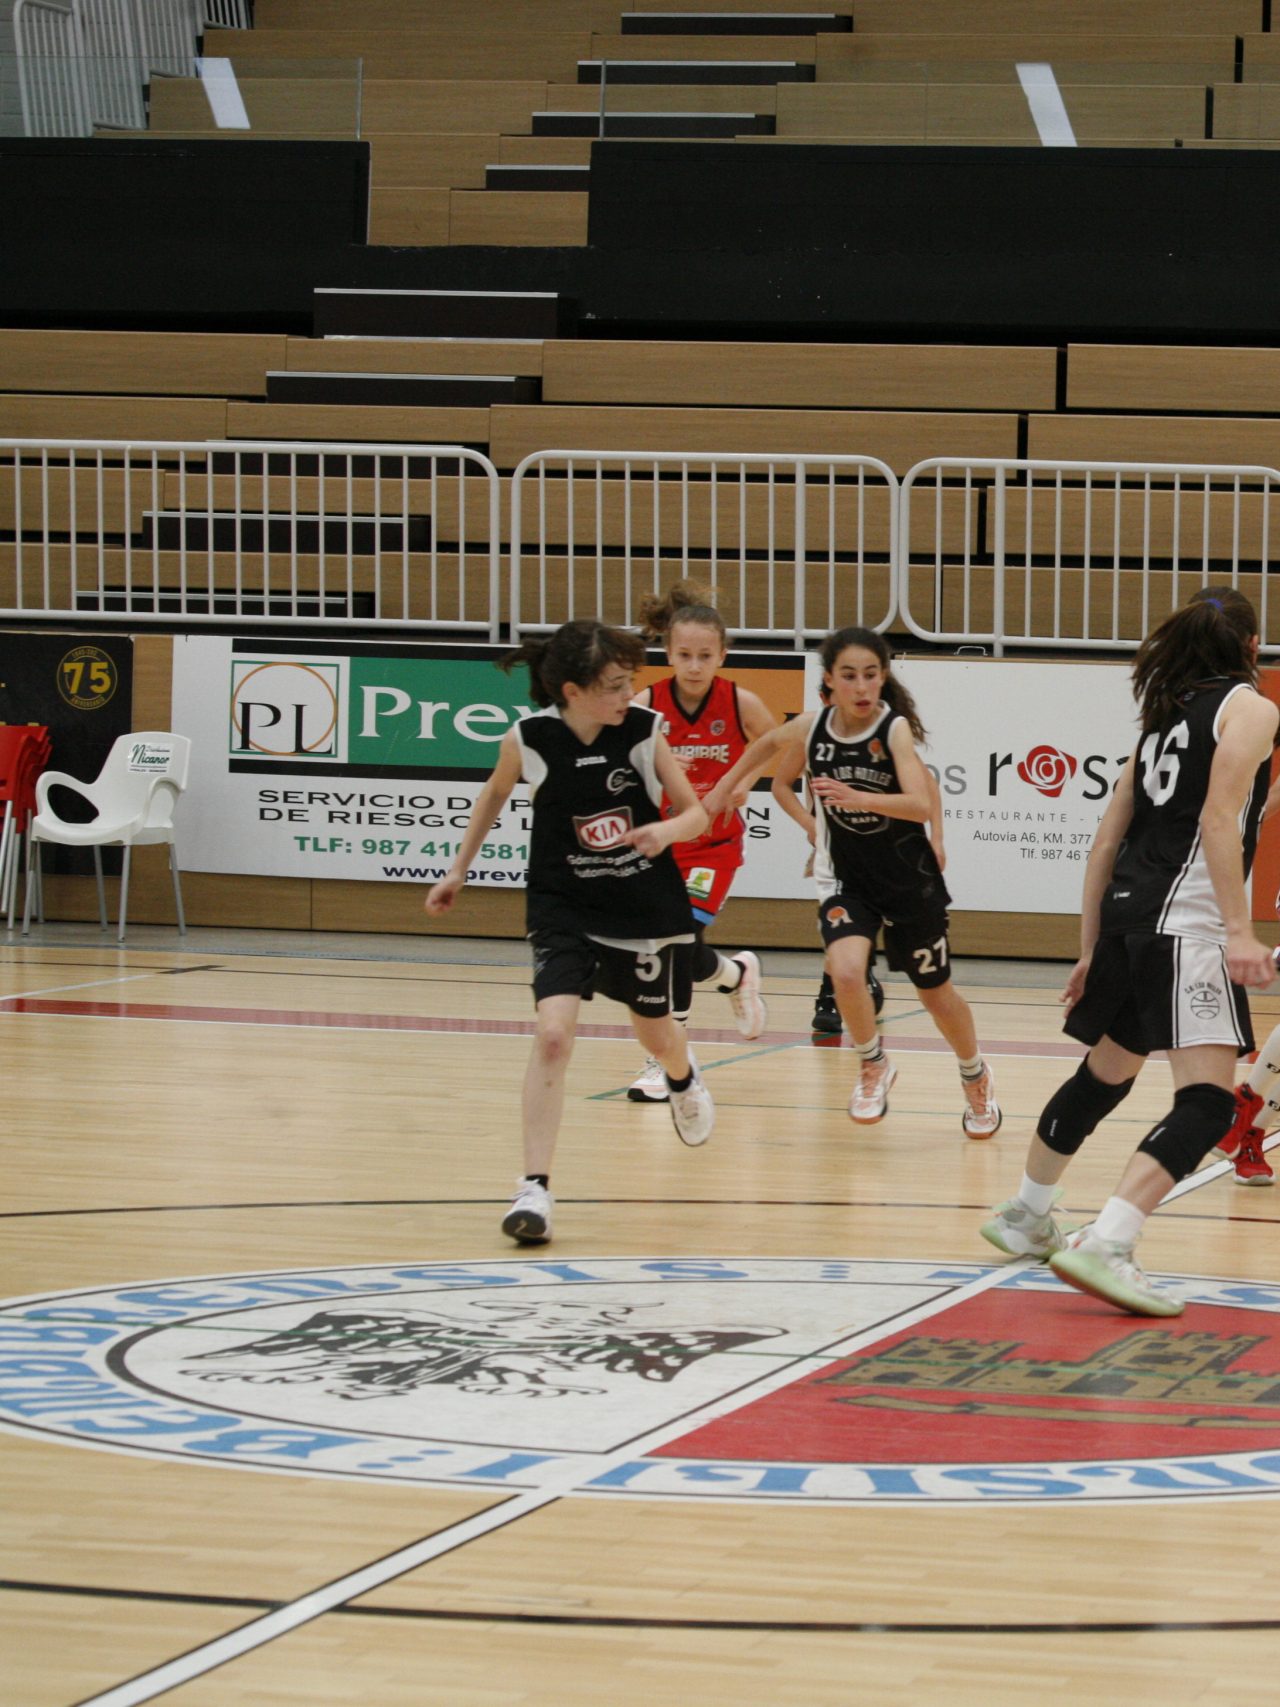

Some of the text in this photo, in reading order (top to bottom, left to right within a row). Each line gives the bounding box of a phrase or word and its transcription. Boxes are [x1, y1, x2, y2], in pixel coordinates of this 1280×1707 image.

[63, 661, 112, 694] 75
[815, 742, 836, 762] 27
[1140, 719, 1190, 807] 16
[258, 789, 435, 810] SERVICIO
[258, 808, 310, 823] DE
[943, 809, 1069, 823] RESTAURANTE
[586, 820, 622, 842] KIA
[1069, 833, 1092, 846] 377
[293, 836, 352, 854] TLF:
[361, 839, 411, 856] 987
[480, 844, 529, 861] 581
[1040, 849, 1063, 861] 987
[1065, 850, 1081, 861] 46
[912, 935, 949, 975] 27
[634, 952, 662, 983] 5
